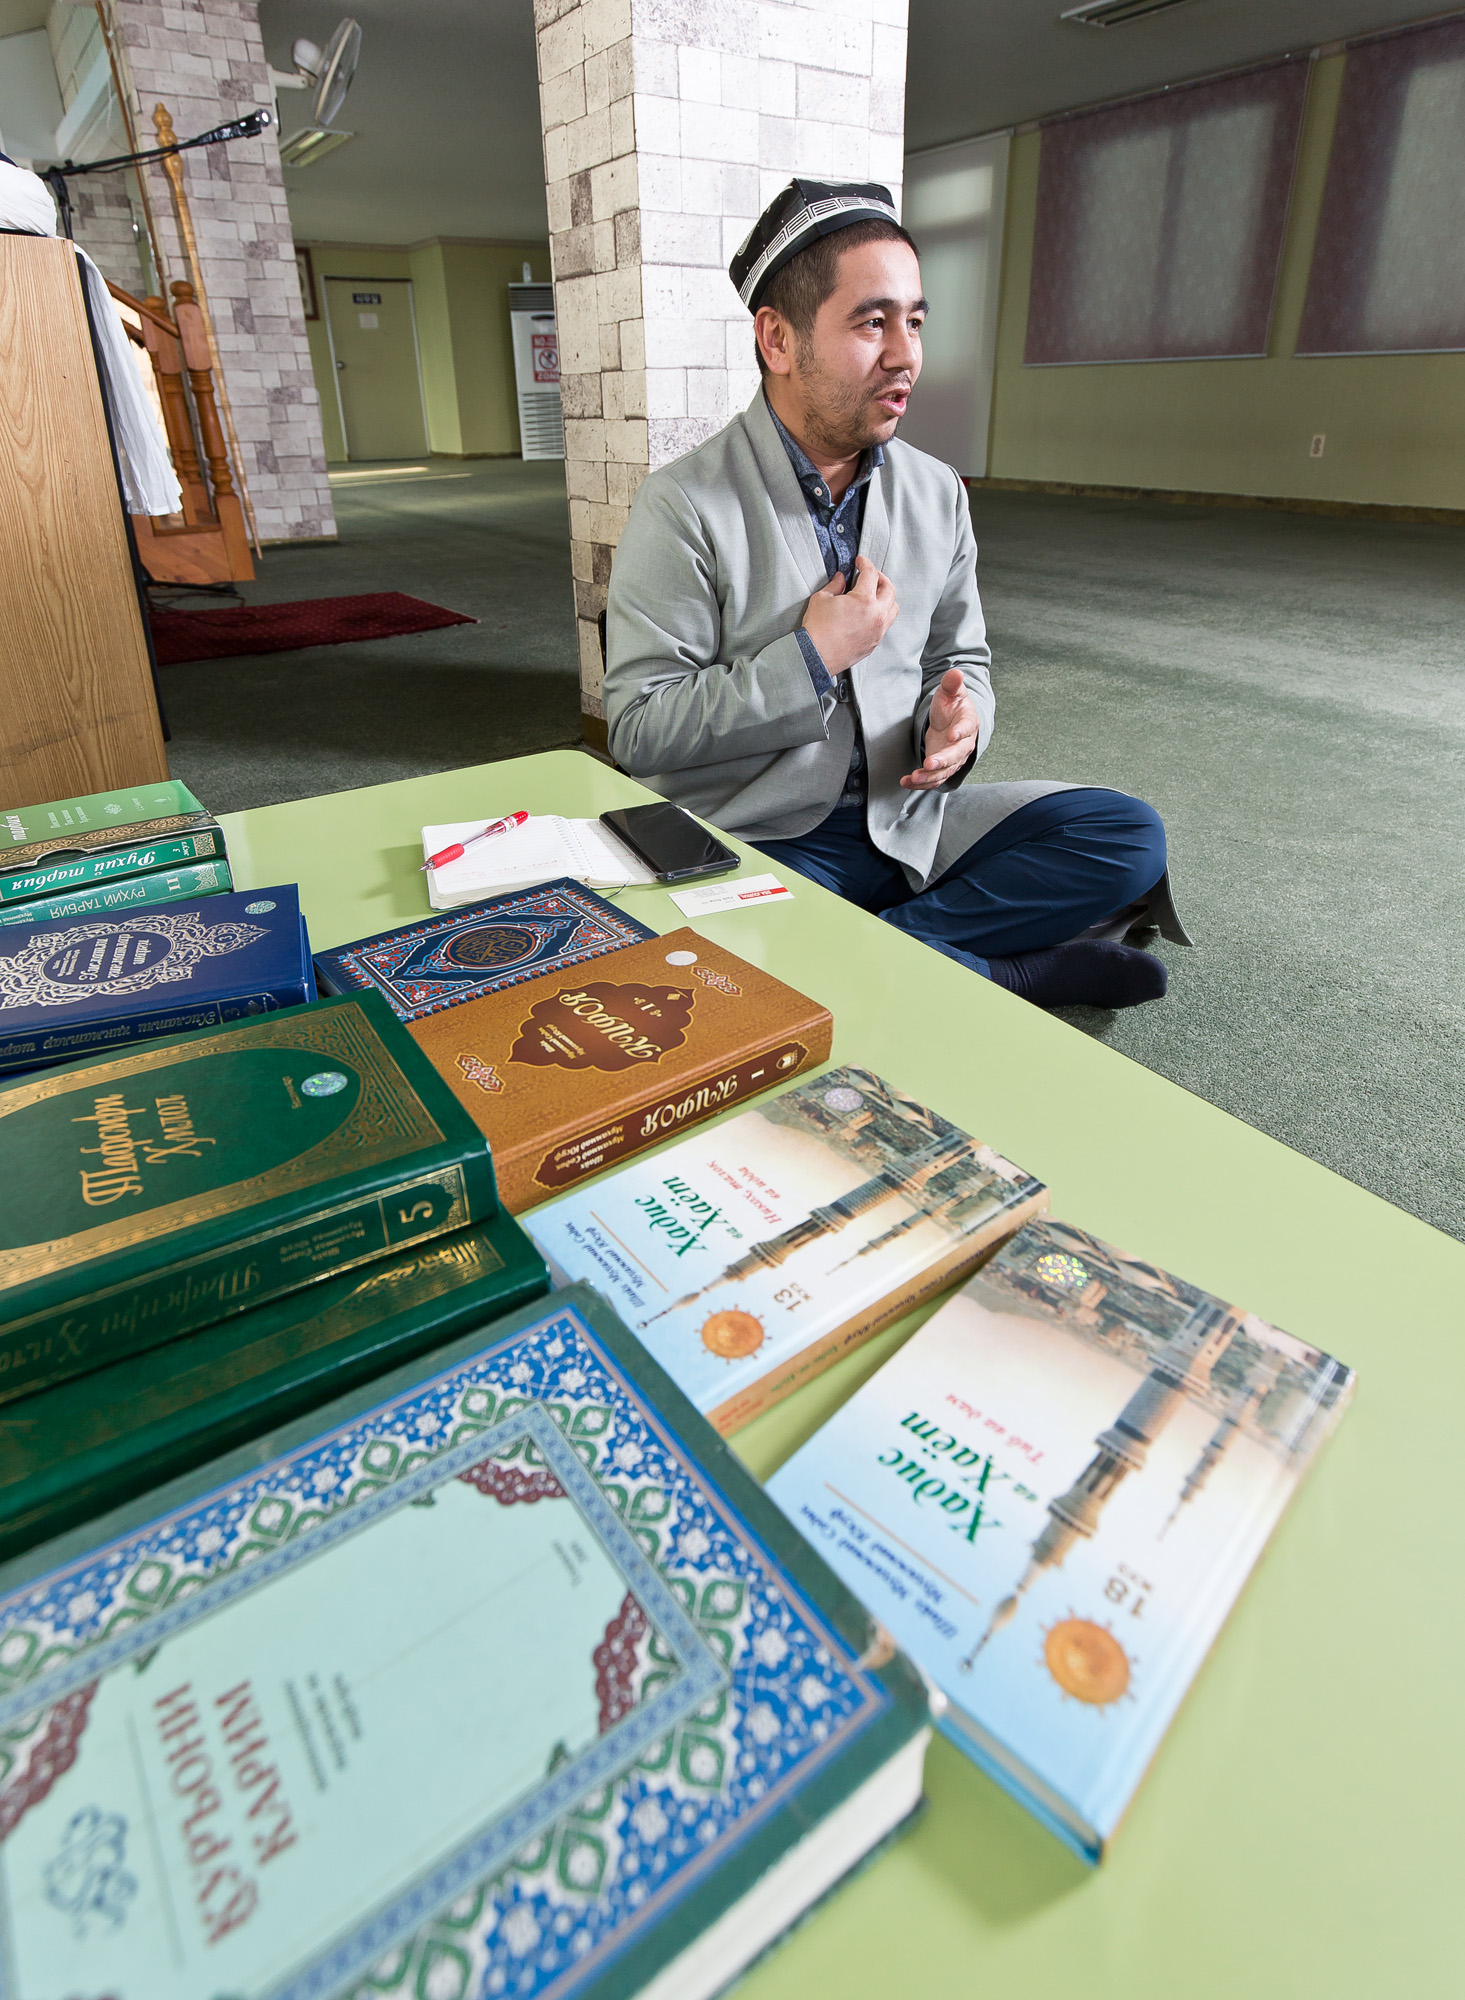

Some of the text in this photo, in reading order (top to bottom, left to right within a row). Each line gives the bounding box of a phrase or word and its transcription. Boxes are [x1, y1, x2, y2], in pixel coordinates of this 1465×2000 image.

[11, 866, 84, 892] тарбия
[49, 897, 103, 919] ТАРБИЯ
[398, 1201, 433, 1224] 5
[635, 1195, 708, 1258] Ҳадис
[661, 1175, 731, 1232] Ҳаёт
[774, 1288, 802, 1312] 13
[899, 1410, 1012, 1496] Ҳаёт
[876, 1446, 1004, 1547] Ҳадис
[1103, 1576, 1148, 1620] 18
[213, 1680, 299, 1867] КАРИМ
